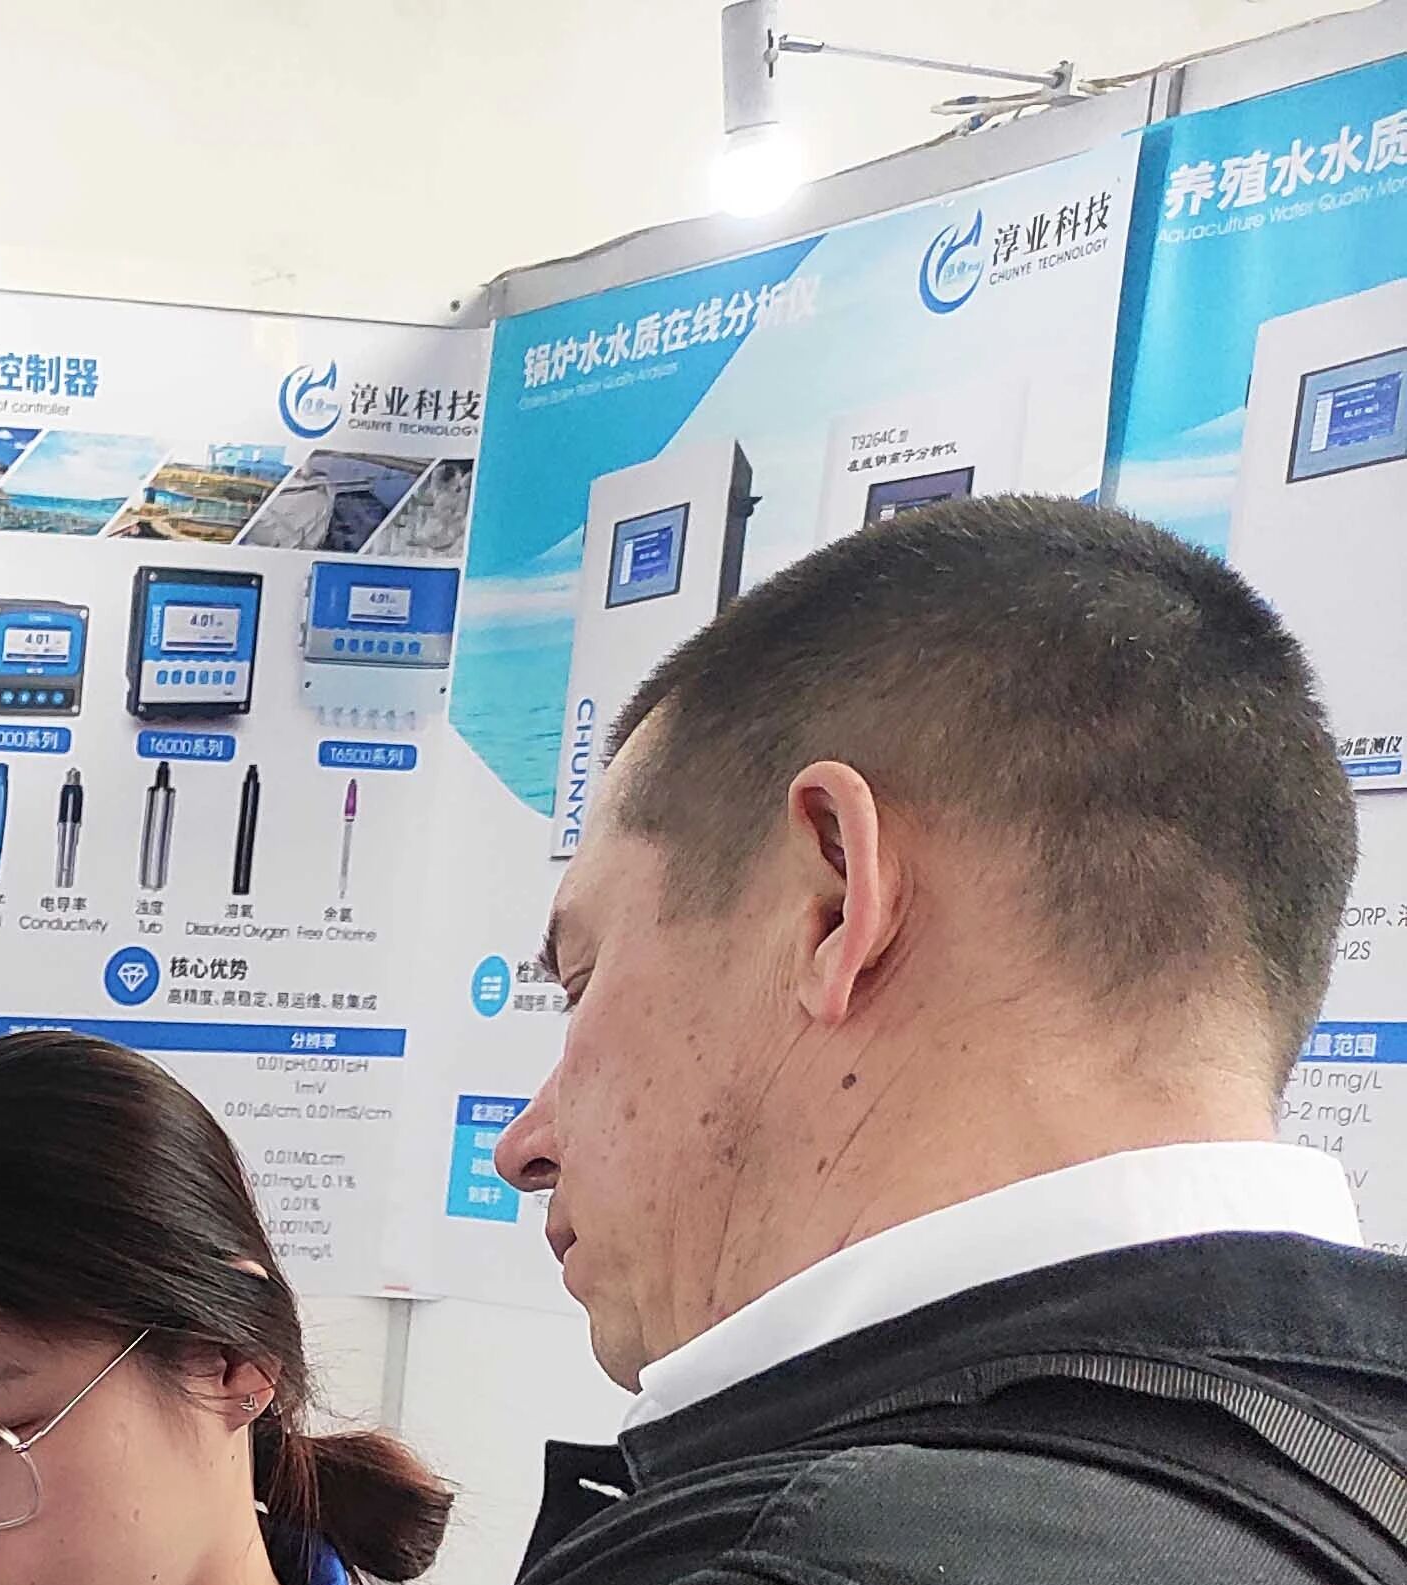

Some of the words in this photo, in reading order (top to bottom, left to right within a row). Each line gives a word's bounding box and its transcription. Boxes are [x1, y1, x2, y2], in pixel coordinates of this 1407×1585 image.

[1163, 109, 1407, 221] 养殖水水质
[1158, 213, 1266, 243] Aquaculture
[1268, 198, 1315, 223] Water
[1319, 185, 1374, 211] Quality
[991, 191, 1113, 267] 淳业科技
[988, 260, 1033, 286] CHUNYE
[1038, 236, 1109, 271] TECHNOLOGY
[523, 274, 822, 389] 锅炉水水质在线分析仪
[350, 382, 482, 422] 淳业科技
[150, 738, 224, 758] T6000系列
[330, 746, 404, 766] T6500系列
[562, 698, 594, 849] CHUNYE
[41, 896, 87, 913] 电导率
[18, 915, 109, 934] Conductivity
[170, 956, 249, 981] 核心优势
[290, 1031, 337, 1050] 分辨率
[294, 1081, 327, 1095] 1mV
[1327, 1070, 1383, 1094] mg/L
[1318, 1103, 1373, 1127] mg/L
